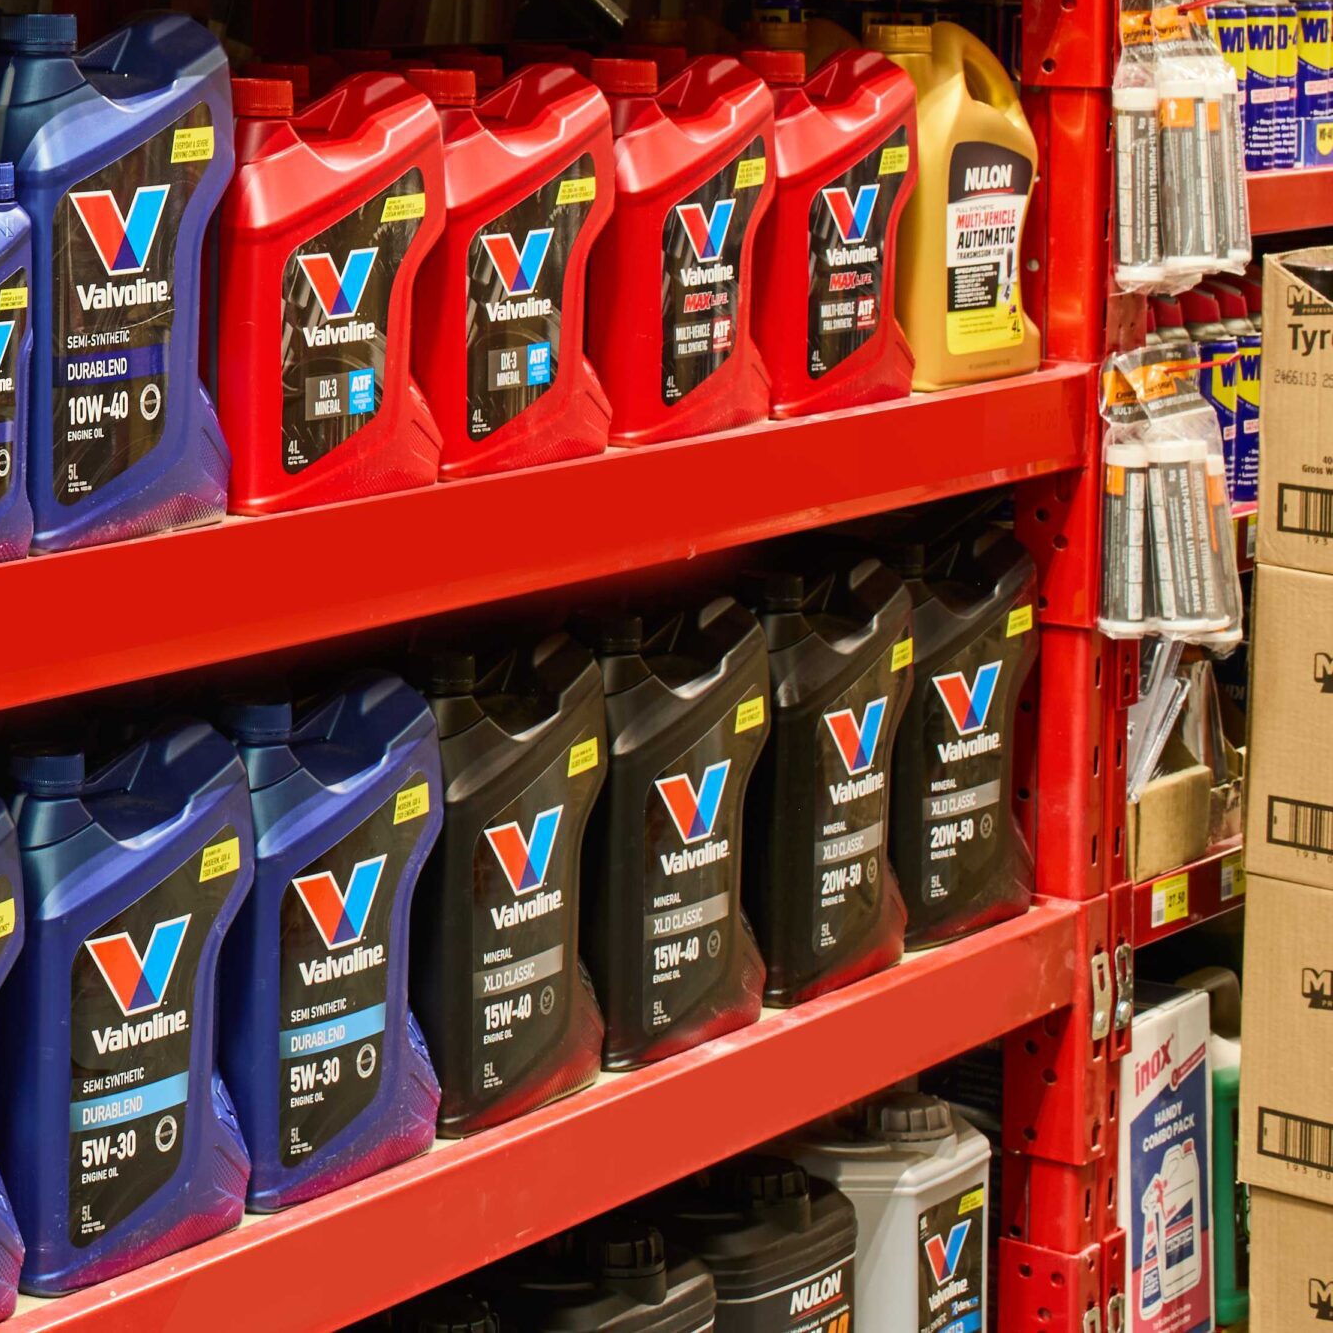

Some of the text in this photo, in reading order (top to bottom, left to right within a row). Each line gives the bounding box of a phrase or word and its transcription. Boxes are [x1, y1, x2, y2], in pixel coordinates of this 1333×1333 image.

[964, 164, 1011, 192] NULON
[955, 210, 1016, 230] MULTI-VEHICLE
[957, 227, 1016, 249] AUTOMATIC
[76, 278, 171, 312] Valvoline
[302, 321, 377, 348] Valvoline
[67, 357, 128, 382] DURABLEND
[351, 374, 371, 392] ATF
[319, 379, 337, 400] DX-3
[67, 392, 129, 426] 10W-40
[315, 399, 341, 416] MINERAL
[938, 732, 1000, 764] Valvoline
[930, 819, 974, 848] 20W-50
[821, 862, 862, 893] 20W-50
[491, 890, 563, 931] Valvoline
[299, 944, 386, 986] Valvoline
[483, 962, 535, 993] XLD CLASSIC
[483, 993, 532, 1029] 15W-40
[91, 1009, 189, 1055] Valvoline
[290, 1057, 340, 1094] 5W-30
[1154, 1099, 1183, 1129] HANDY
[81, 1129, 136, 1168] 5W-30
[1142, 1113, 1195, 1153] COMBO PACK
[790, 1270, 842, 1315] NULON
